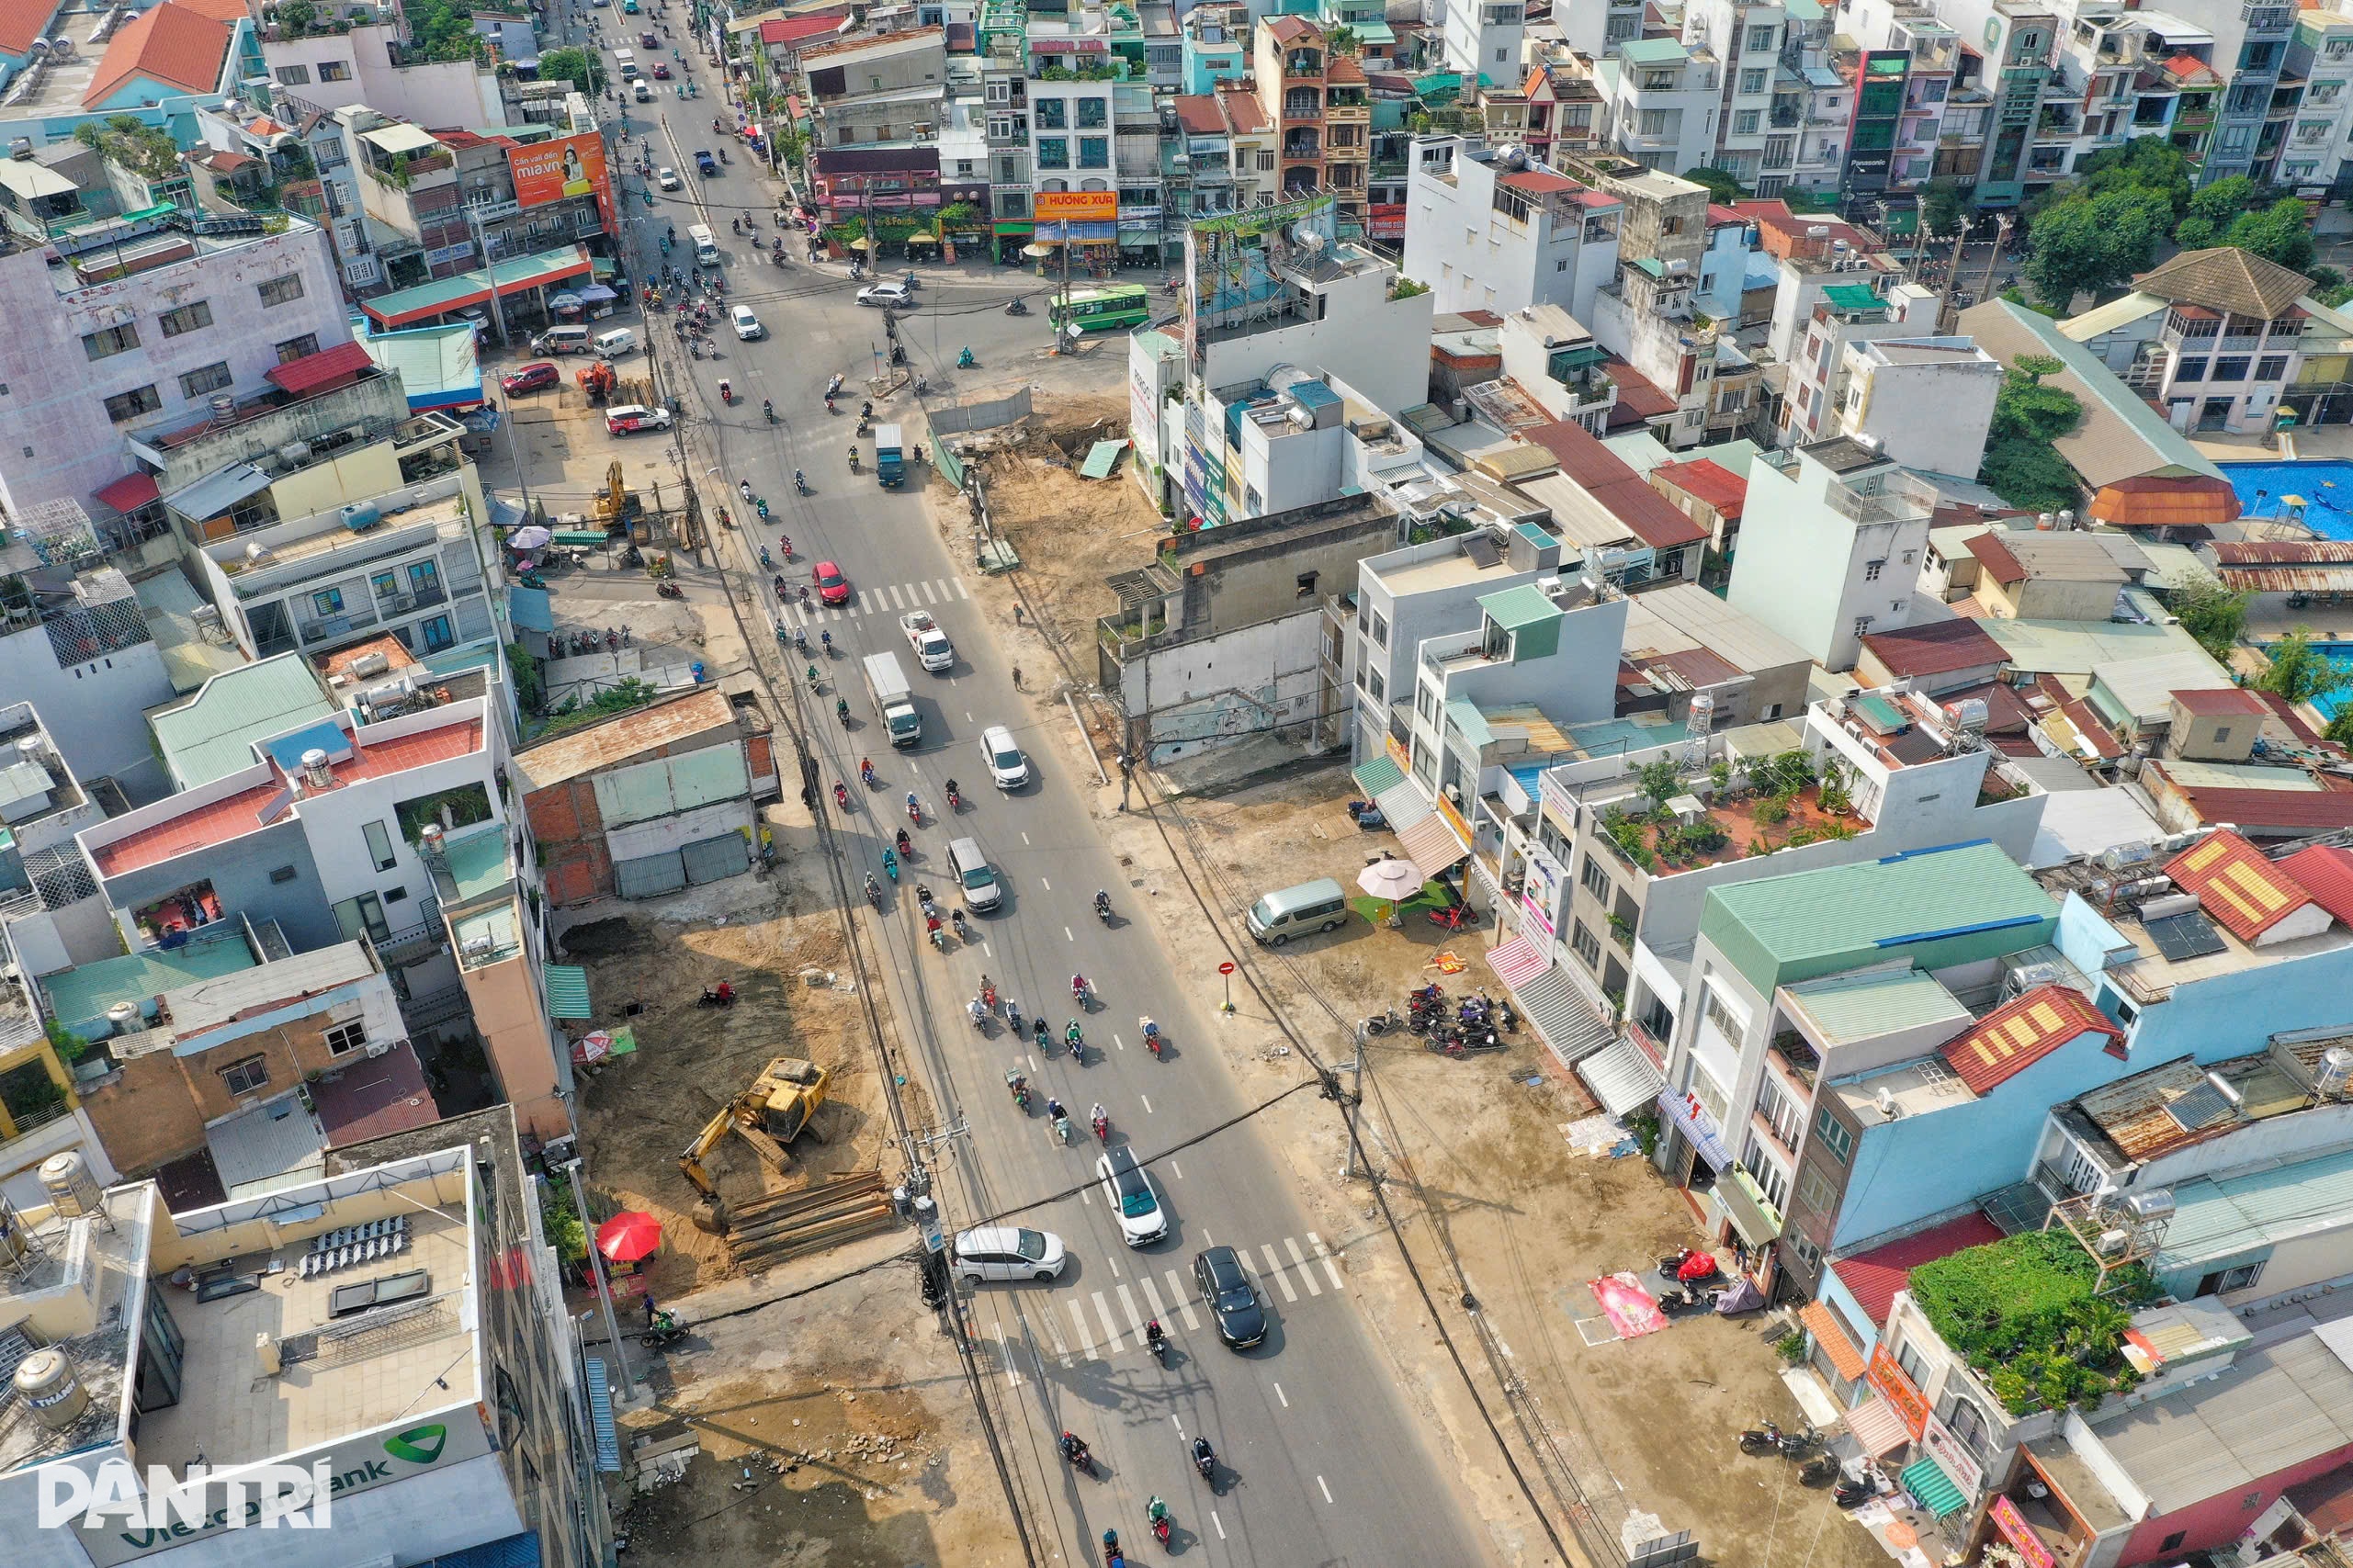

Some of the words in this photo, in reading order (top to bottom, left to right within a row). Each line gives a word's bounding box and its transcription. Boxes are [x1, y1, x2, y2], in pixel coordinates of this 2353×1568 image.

[516, 161, 560, 179] mia.vn
[1092, 195, 1113, 205] XƯA
[1135, 368, 1150, 400] PERGO
[120, 1461, 393, 1549] Vietcombank
